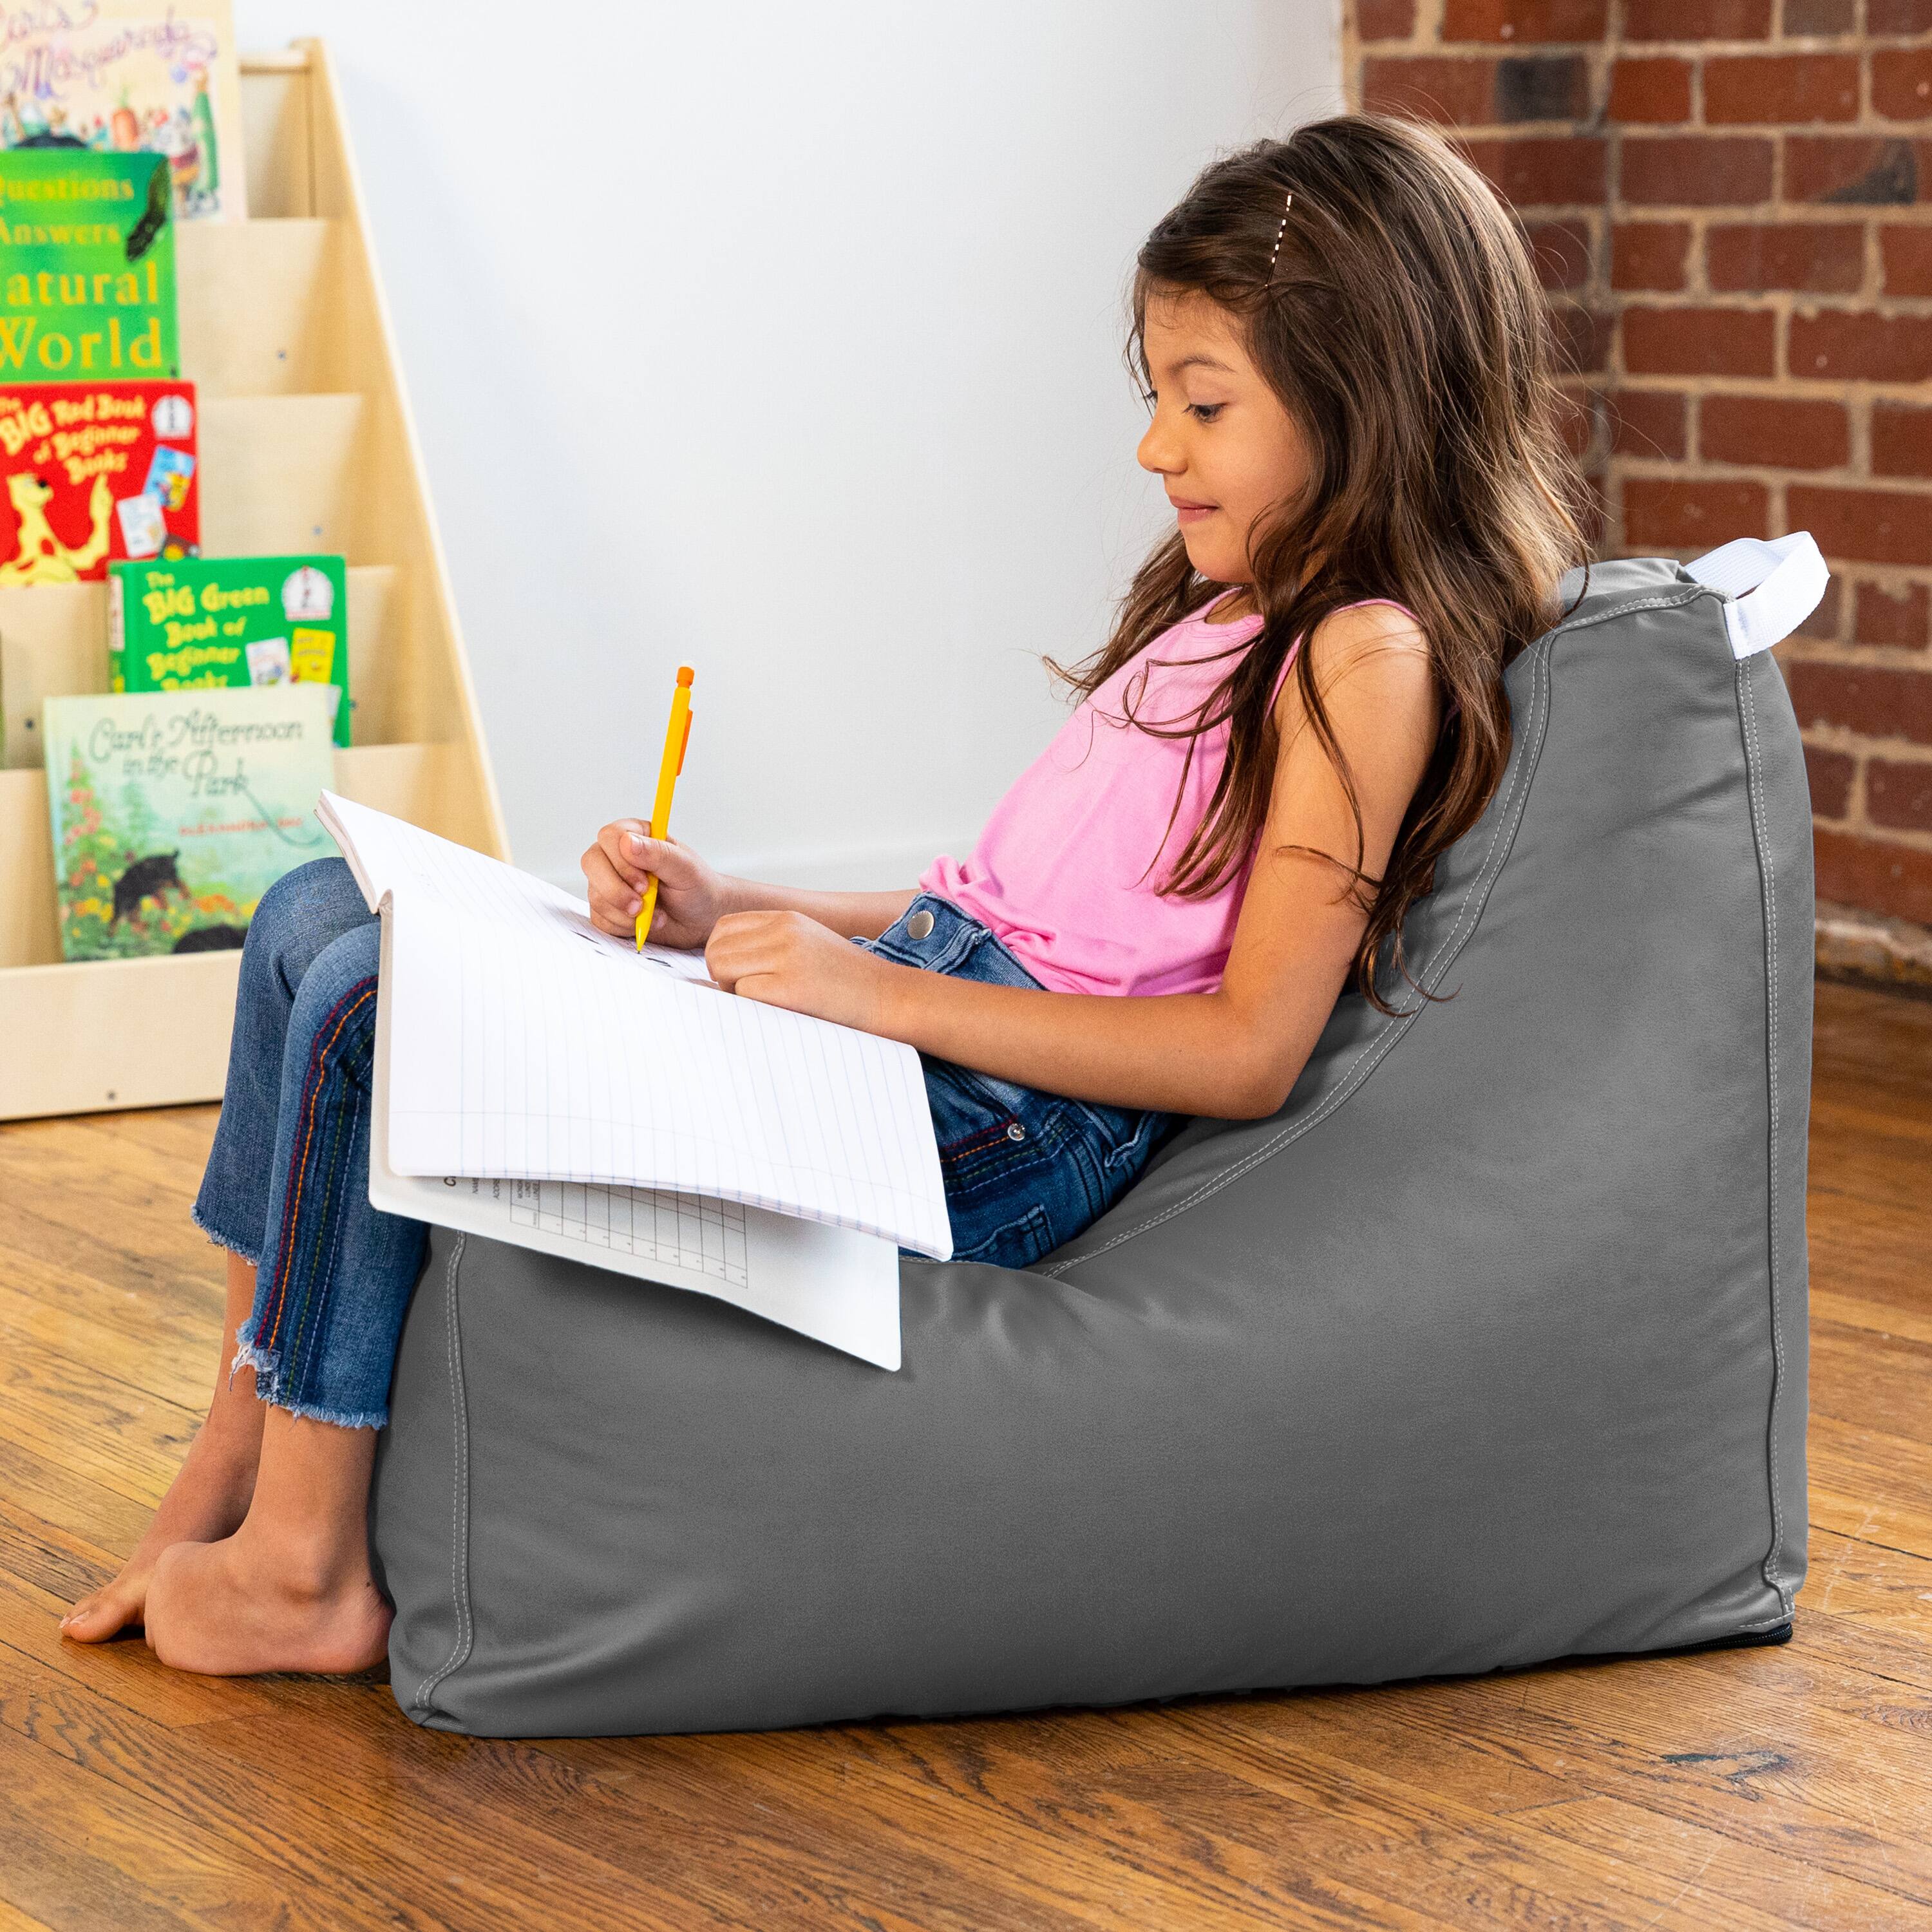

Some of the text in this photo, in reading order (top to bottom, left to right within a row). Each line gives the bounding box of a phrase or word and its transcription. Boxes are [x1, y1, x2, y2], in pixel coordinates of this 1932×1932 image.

[0, 402, 52, 456] BIG
[51, 400, 94, 426] Red
[97, 394, 146, 420] Book
[33, 440, 51, 464] of
[51, 426, 141, 460] Beginner
[64, 448, 128, 485] Books
[146, 571, 175, 589] The
[142, 586, 195, 625] BIG
[200, 582, 270, 612] Green
[164, 615, 247, 648] Book of
[147, 647, 240, 681] Beginner
[88, 707, 303, 764] Carl's Afternoon
[123, 748, 179, 782] in the
[182, 749, 249, 797] Park
